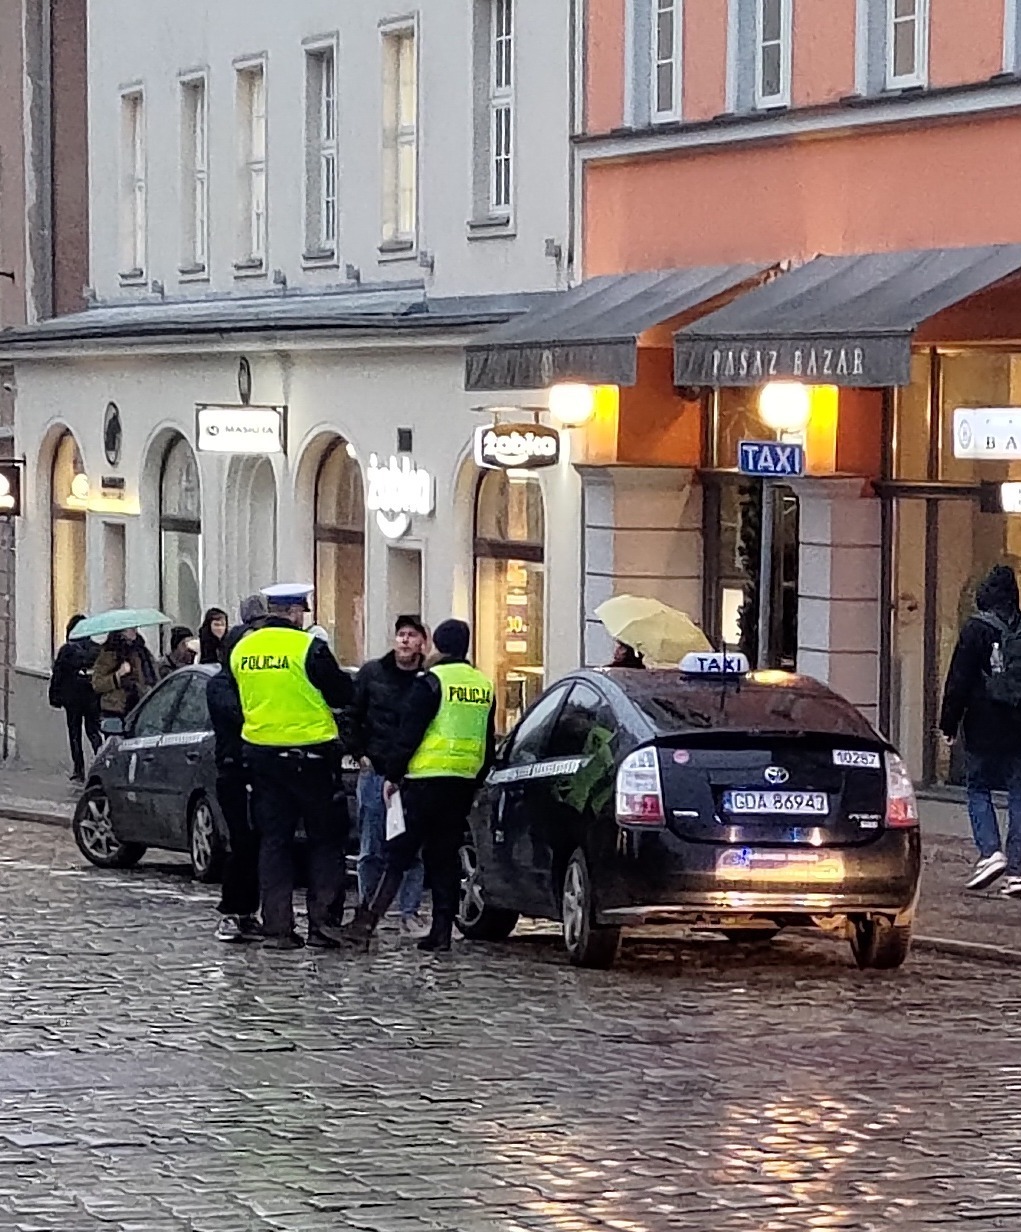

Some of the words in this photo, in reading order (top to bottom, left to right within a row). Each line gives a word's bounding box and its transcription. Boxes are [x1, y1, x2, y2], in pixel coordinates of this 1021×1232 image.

[794, 347, 864, 376] BAZAR
[742, 444, 801, 474] TAXI
[241, 655, 290, 670] POLICJA
[697, 657, 741, 672] TAXI
[734, 792, 768, 810] GDA
